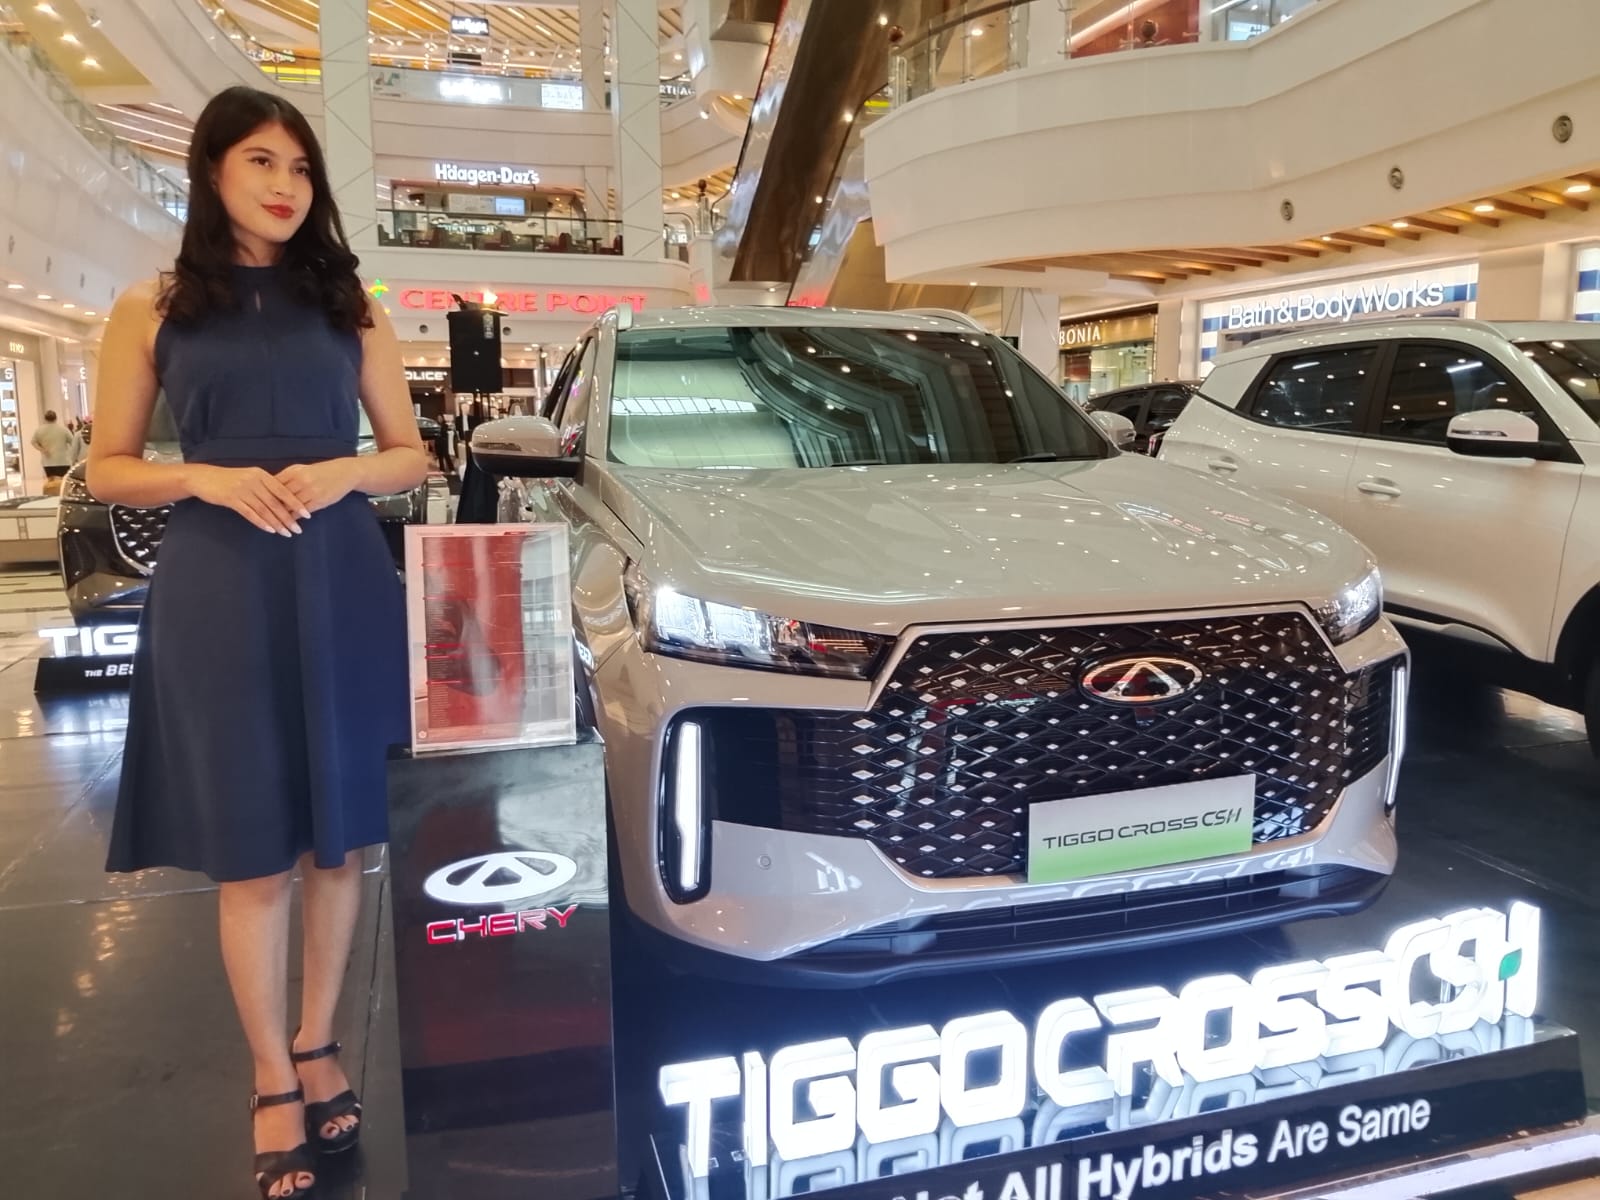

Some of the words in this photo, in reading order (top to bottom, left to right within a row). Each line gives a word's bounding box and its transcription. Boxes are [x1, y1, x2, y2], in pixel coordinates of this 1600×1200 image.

[1229, 300, 1274, 328] Bath
[1276, 297, 1294, 323] &
[1296, 289, 1359, 322] Body
[1360, 280, 1444, 314] Works
[1059, 324, 1101, 346] BONIA
[38, 624, 140, 658] TIG
[84, 669, 103, 677] THE
[1042, 828, 1114, 849] TIGGO
[1117, 816, 1198, 839] CROSS
[1201, 807, 1243, 828] CSH
[426, 903, 579, 944] CHERY
[660, 1010, 1027, 1177] TIGGO
[1033, 949, 1396, 1107] CROSS
[1385, 900, 1541, 1039] CSH
[1077, 1128, 1259, 1200] Hybrids
[1267, 1119, 1328, 1162] Are
[1336, 1097, 1432, 1149] Same
